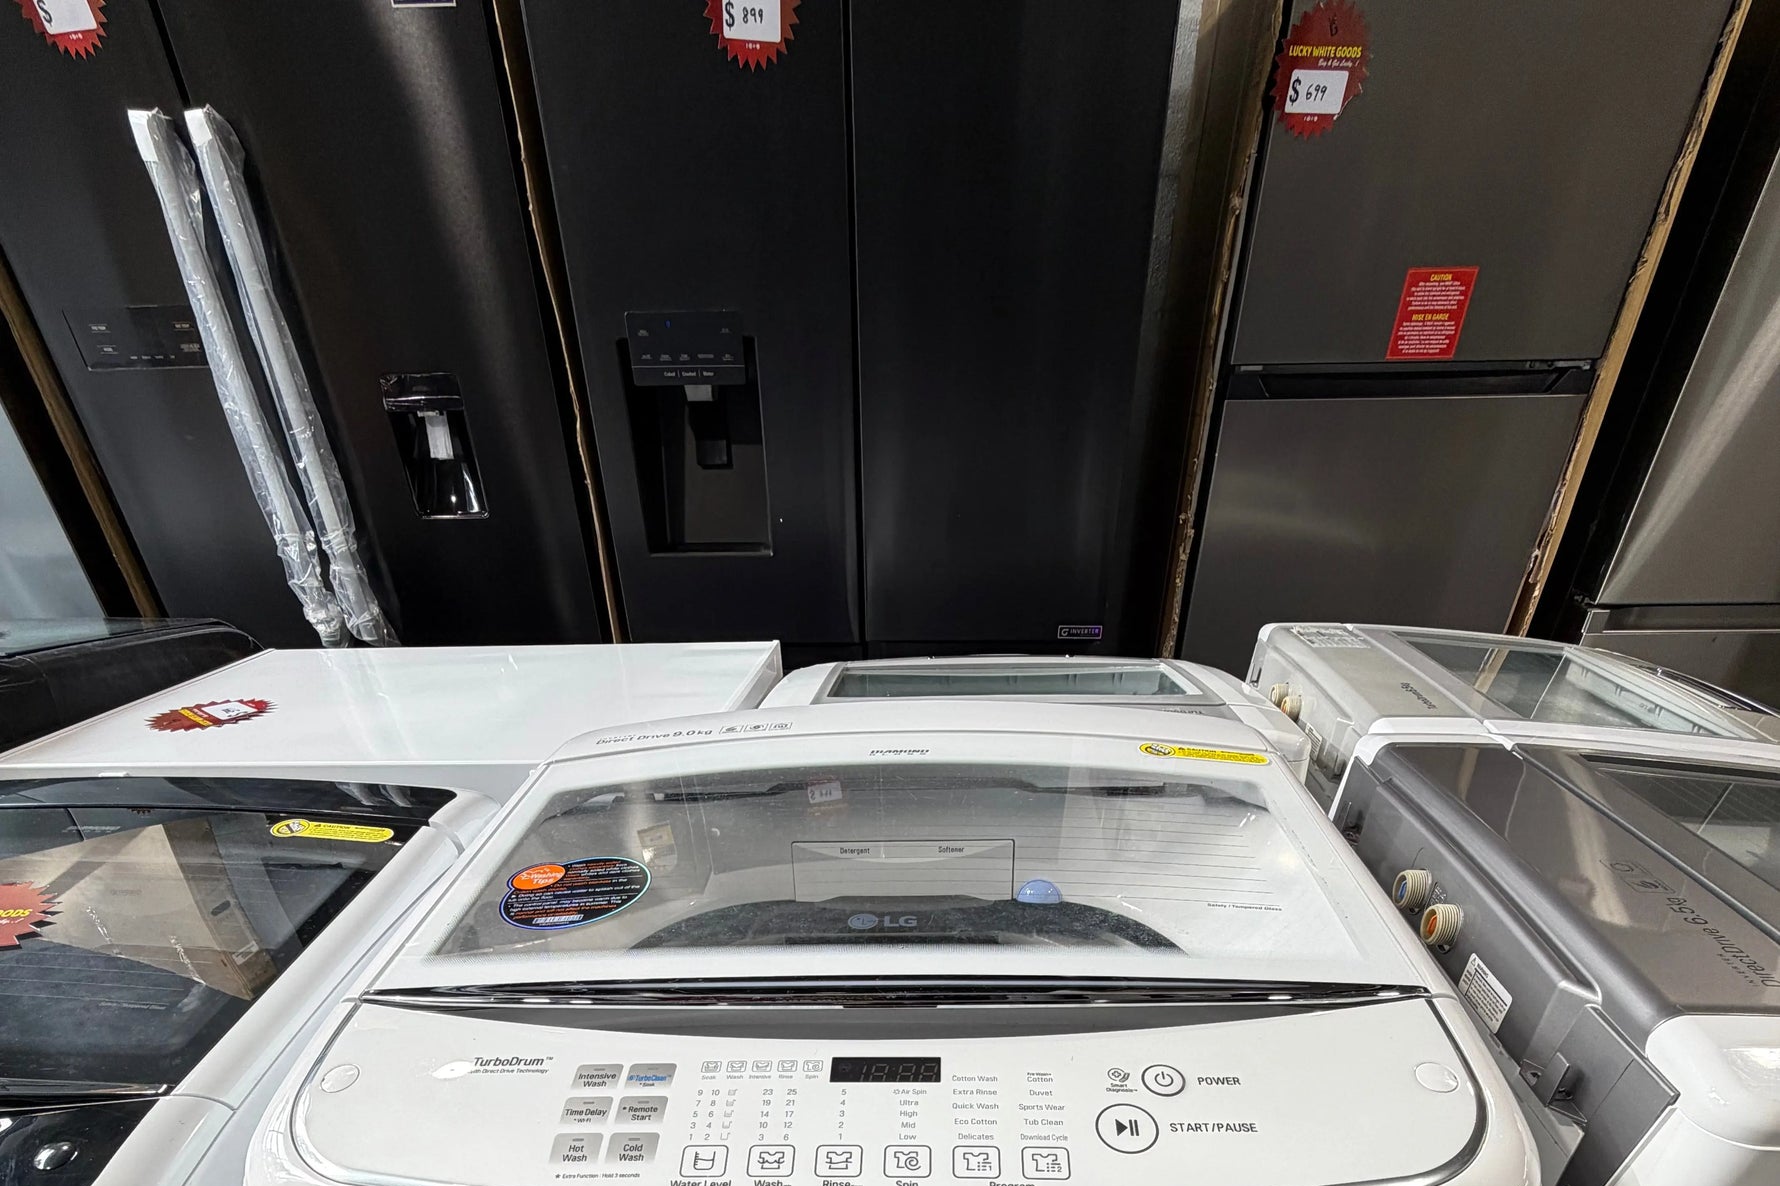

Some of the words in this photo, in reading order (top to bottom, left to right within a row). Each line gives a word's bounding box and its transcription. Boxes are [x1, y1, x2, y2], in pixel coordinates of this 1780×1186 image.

[725, 0, 735, 31] $
[742, 6, 764, 24] 899
[1289, 45, 1312, 57] LUCKY
[1313, 46, 1335, 58] WHITE
[1336, 46, 1362, 58] GOODS
[1289, 76, 1302, 106] $
[1306, 83, 1327, 101] 699
[1430, 273, 1453, 281] CAUTION
[884, 915, 917, 927] LG
[583, 1080, 607, 1088] Wash
[1197, 1076, 1241, 1086] POWER
[912, 1088, 927, 1096] Spin
[952, 1088, 974, 1096] Extra
[976, 1088, 998, 1096] Rinse
[952, 1102, 975, 1110] Quick
[976, 1102, 999, 1110] Wash
[565, 1108, 584, 1116] Time
[584, 1108, 608, 1117] Delay
[760, 1110, 770, 1118] 14
[786, 1110, 794, 1118] 17
[900, 1110, 918, 1118] High
[1024, 1118, 1039, 1126] Tub
[1040, 1118, 1064, 1126] Clean
[1170, 1122, 1258, 1133] START/PAUSE
[899, 1133, 917, 1141] Low
[1051, 1134, 1068, 1142] Cycle
[568, 1144, 584, 1153] Hot
[623, 1144, 643, 1152] Cold
[562, 1154, 588, 1162] Wash
[619, 1154, 645, 1162] Wash
